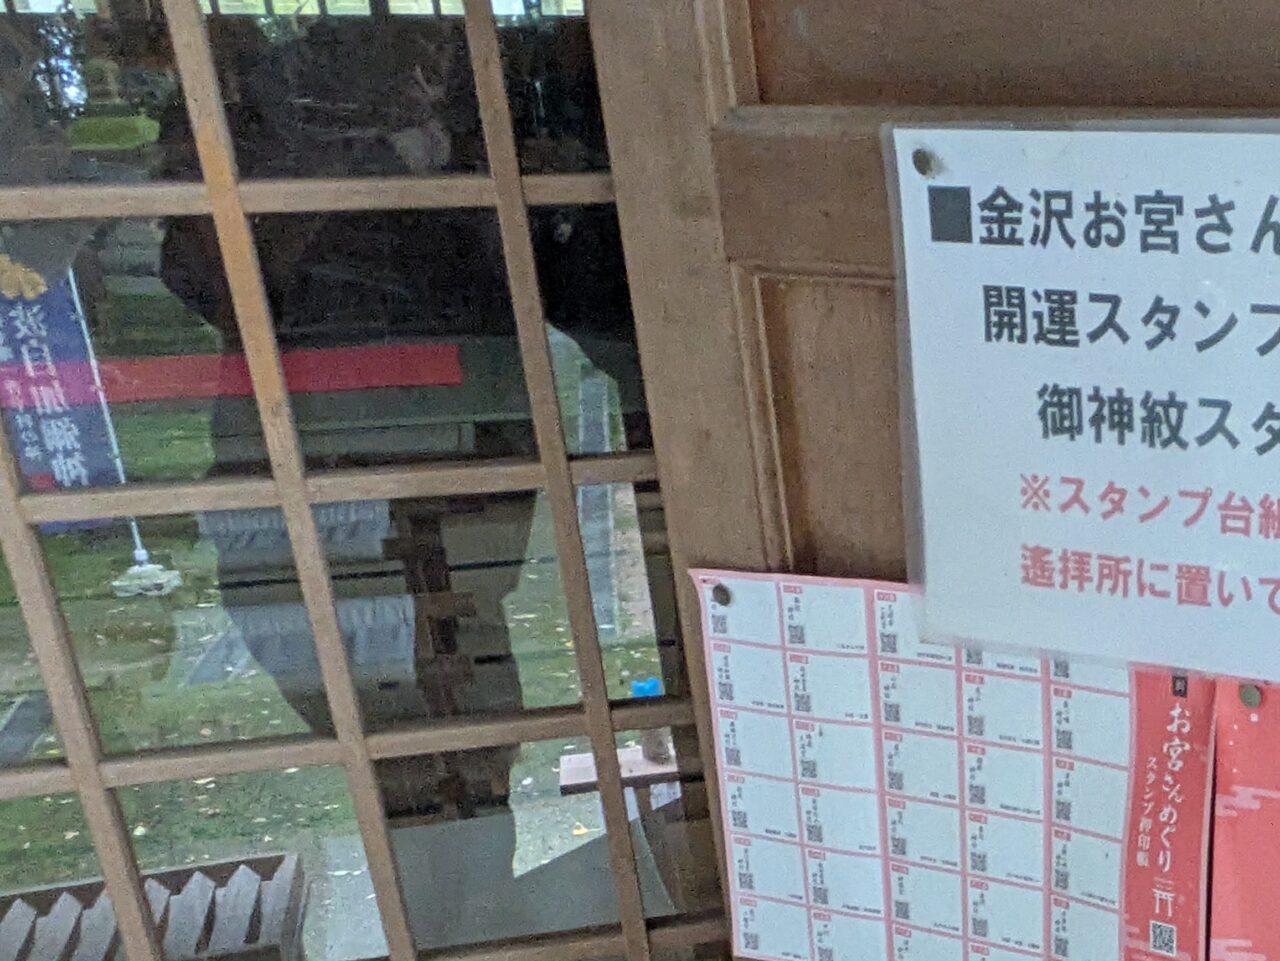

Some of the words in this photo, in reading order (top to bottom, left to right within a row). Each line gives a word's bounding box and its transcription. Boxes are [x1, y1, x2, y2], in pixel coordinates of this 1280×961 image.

[1161, 702, 1191, 872] お宮さんめぐり
